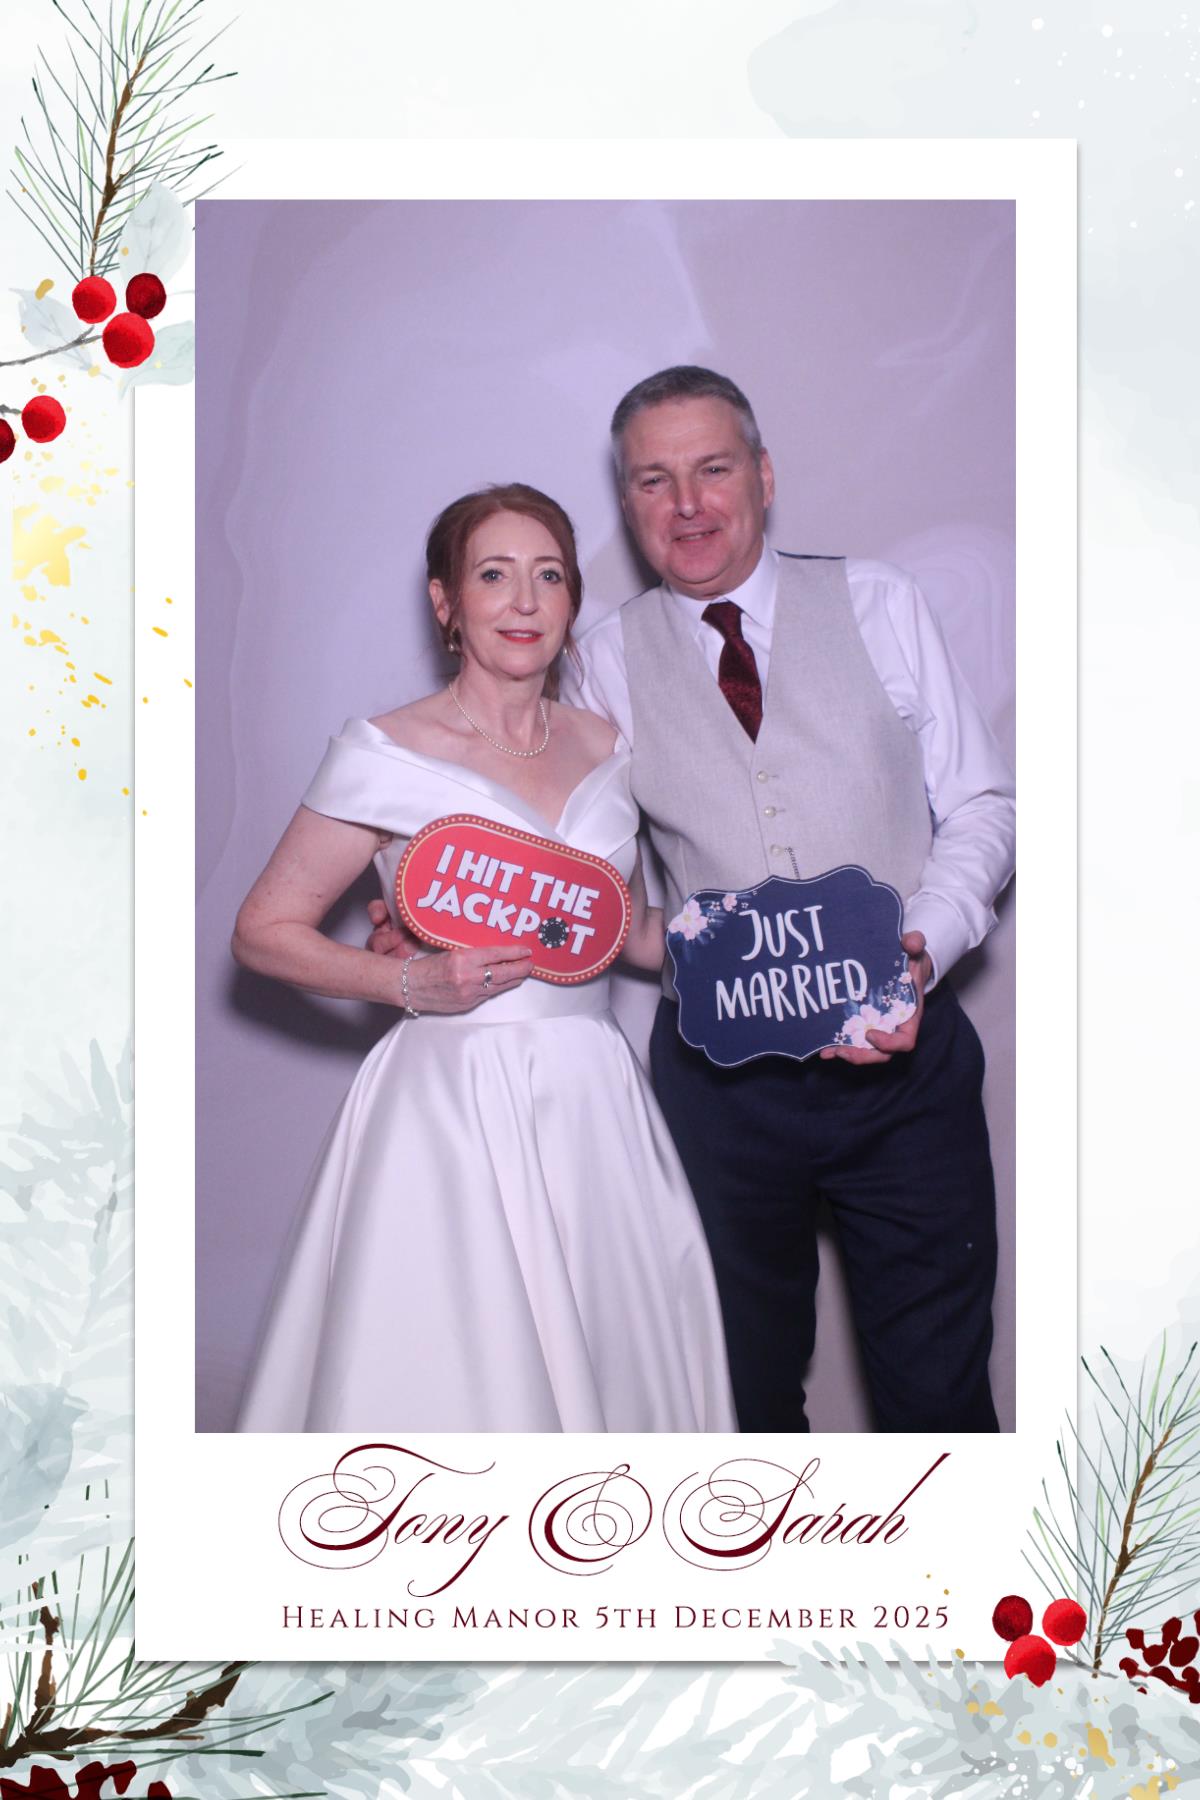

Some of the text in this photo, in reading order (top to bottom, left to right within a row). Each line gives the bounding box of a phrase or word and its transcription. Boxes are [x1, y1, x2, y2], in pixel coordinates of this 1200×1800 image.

[436, 844, 599, 919] I HIT THE
[738, 905, 824, 961] JUST
[716, 959, 868, 1022] MARRIED
